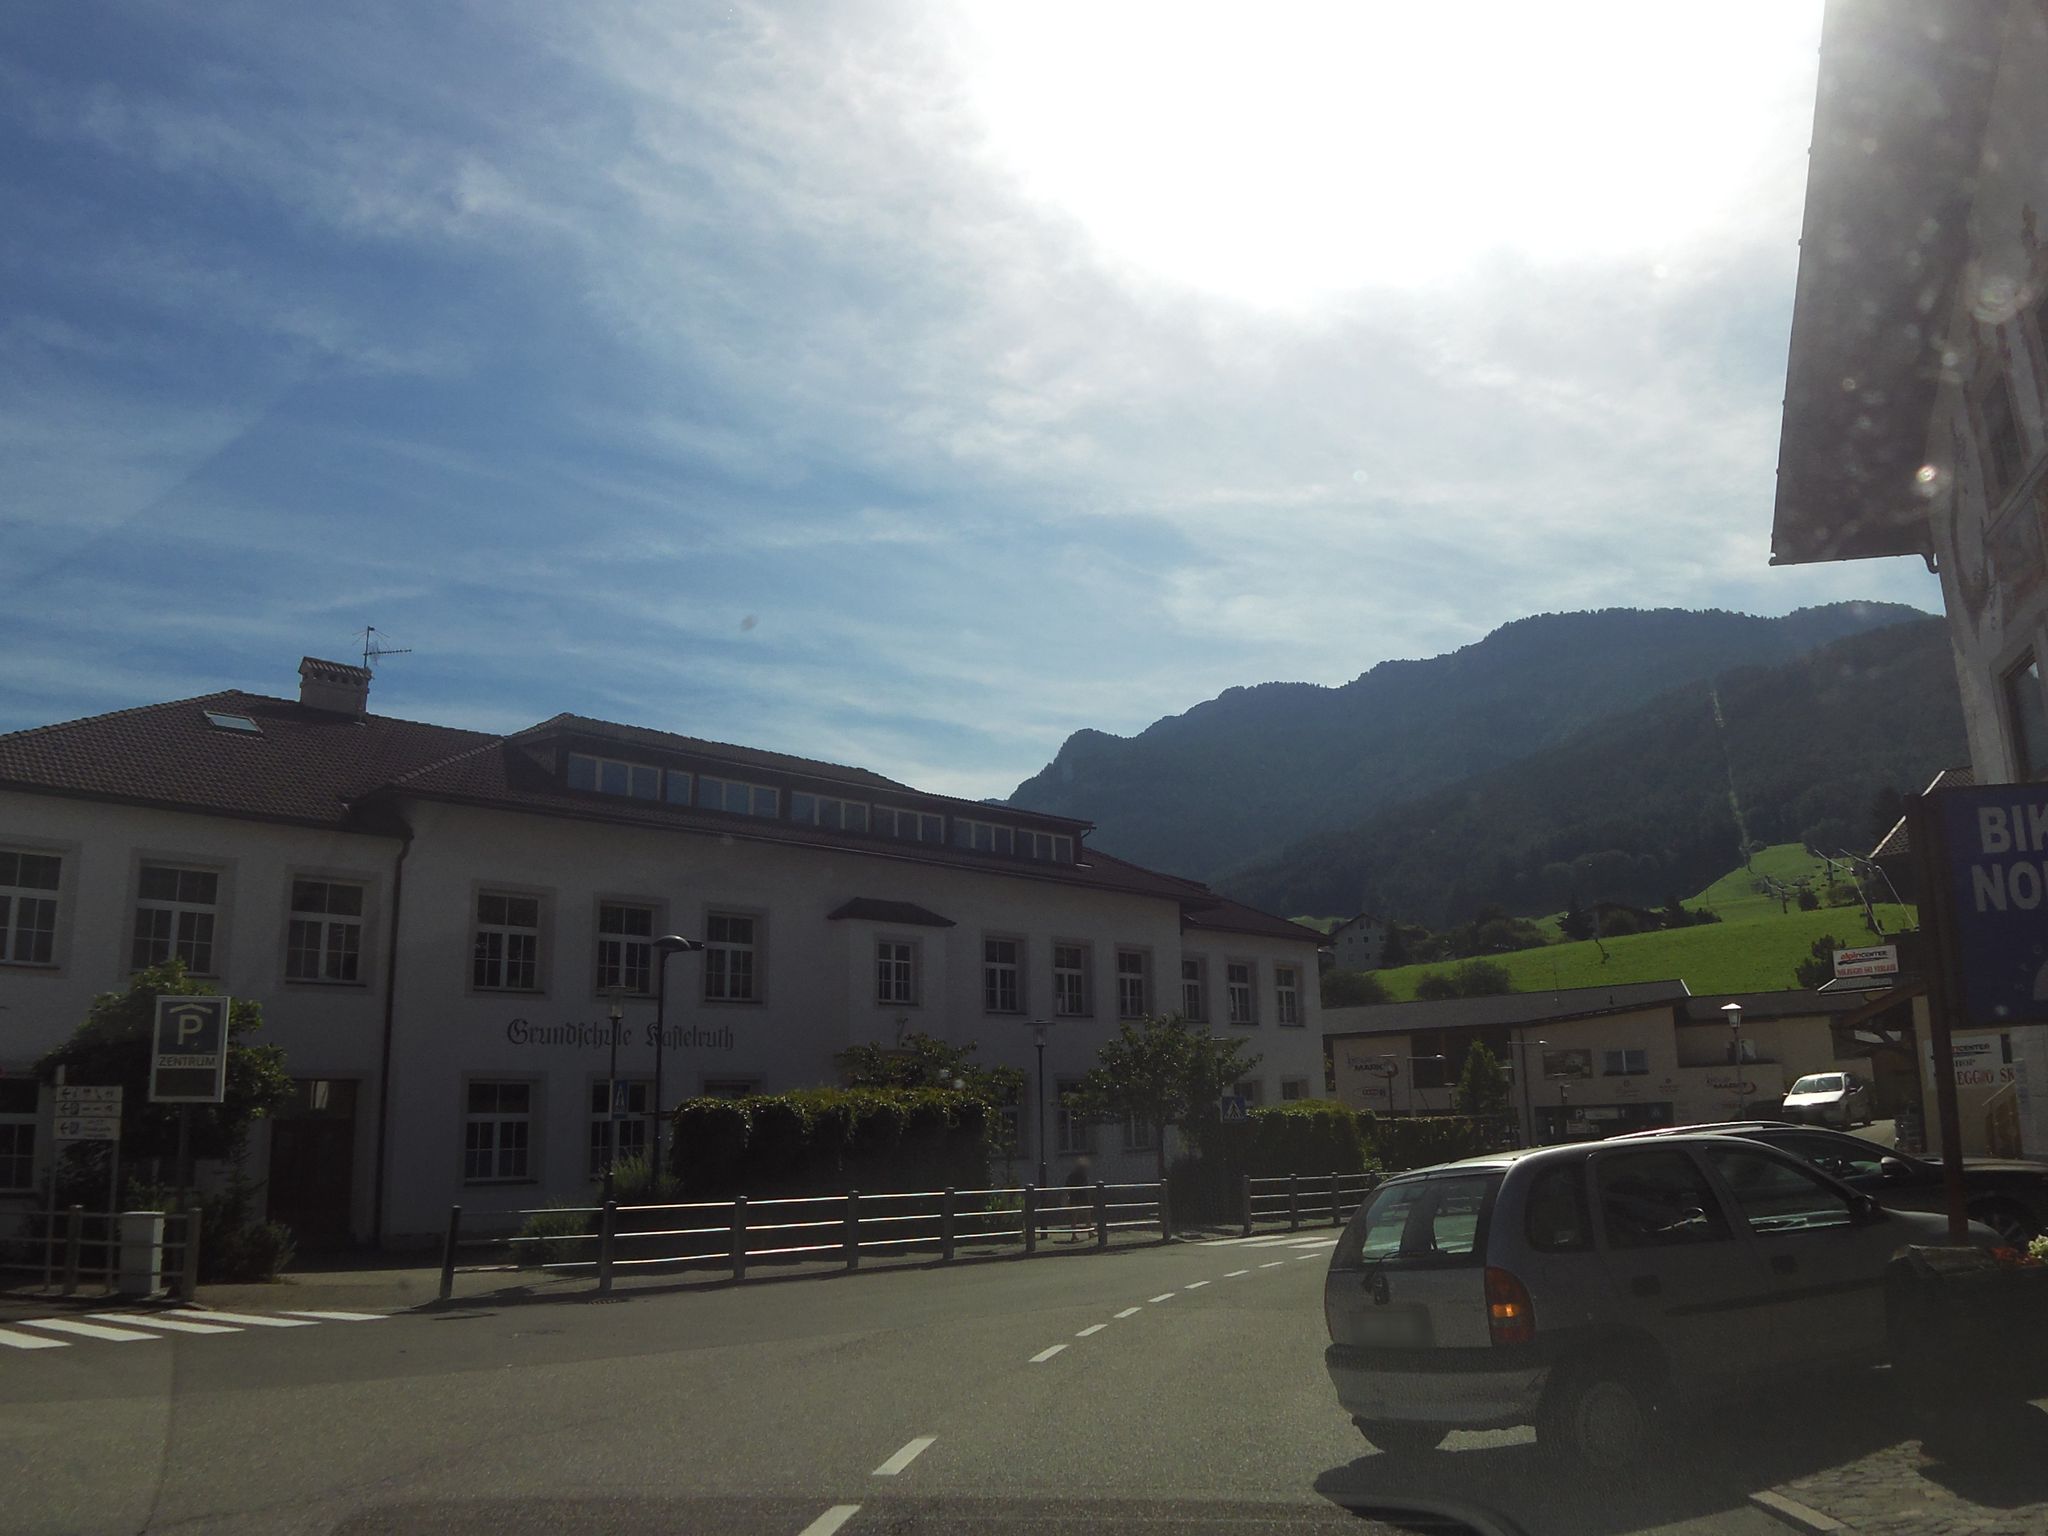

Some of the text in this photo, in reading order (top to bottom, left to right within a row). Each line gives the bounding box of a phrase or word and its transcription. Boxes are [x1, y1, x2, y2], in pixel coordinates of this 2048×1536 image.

[1971, 860, 2048, 912] NO
[177, 1014, 204, 1046] P
[158, 1056, 216, 1067] ZENTRUM
